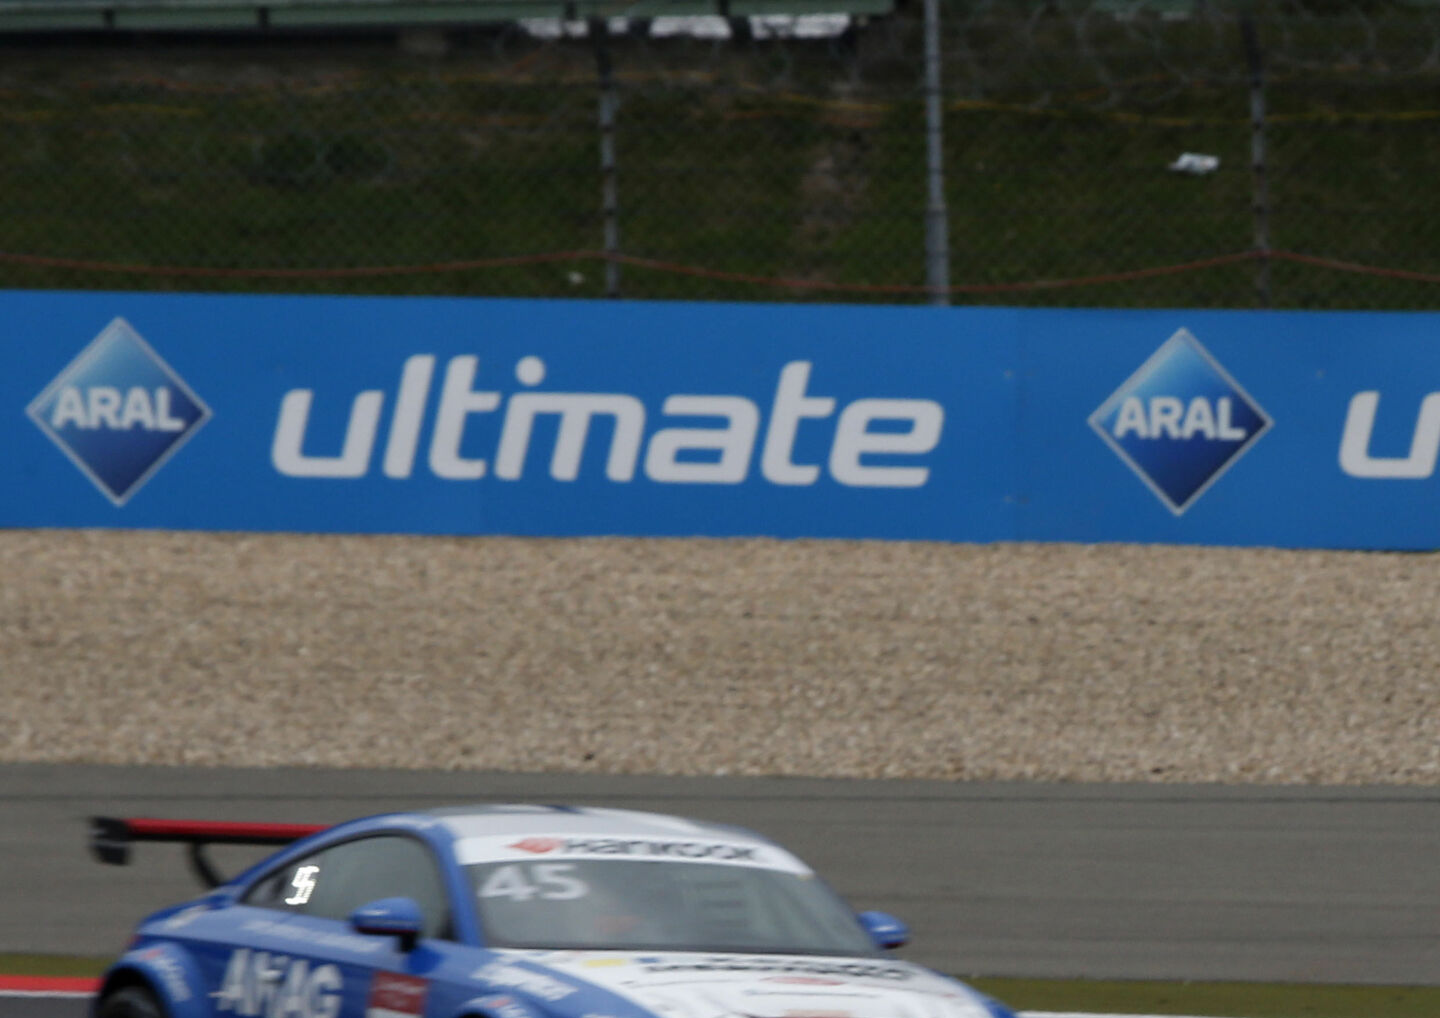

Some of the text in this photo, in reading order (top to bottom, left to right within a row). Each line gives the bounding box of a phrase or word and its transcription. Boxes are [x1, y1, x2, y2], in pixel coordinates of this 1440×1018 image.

[52, 385, 185, 432] ARAL
[271, 354, 945, 488] ultimate
[1112, 397, 1246, 441] ARAL
[481, 864, 589, 900] 45
